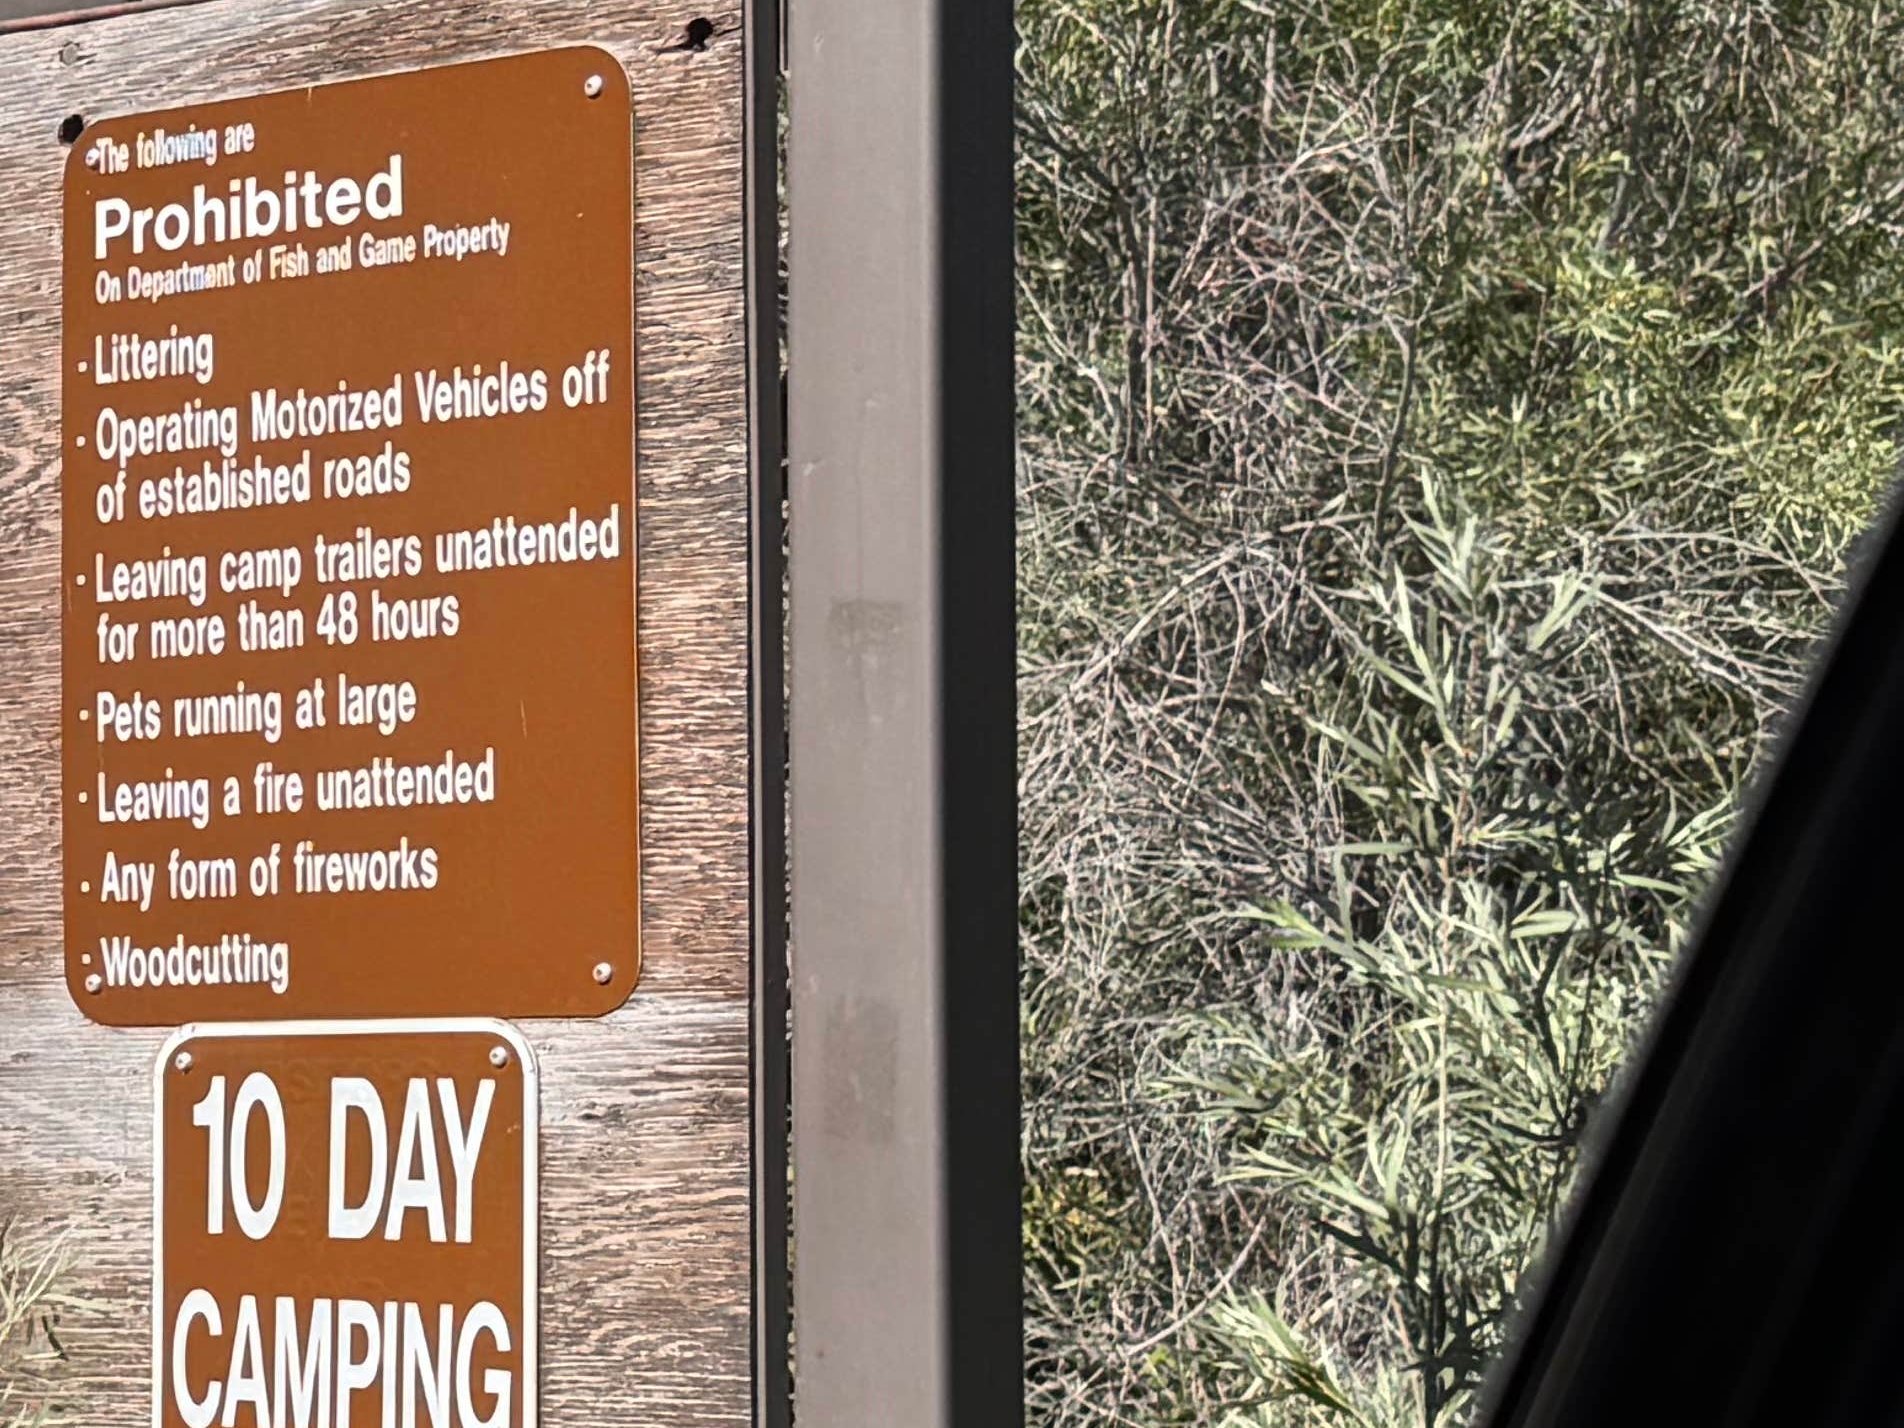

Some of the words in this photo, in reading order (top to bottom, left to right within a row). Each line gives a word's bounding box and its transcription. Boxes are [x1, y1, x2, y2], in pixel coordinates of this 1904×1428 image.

[95, 135, 128, 174] The
[136, 125, 218, 168] following
[224, 122, 255, 153] are
[95, 154, 404, 260] Prohibited
[95, 270, 121, 304] On
[128, 258, 235, 303] Department
[243, 253, 262, 283] of
[269, 245, 309, 279] Fish
[316, 236, 352, 273] and
[358, 230, 416, 266] Game
[423, 217, 510, 260] Property
[95, 324, 213, 385] Littering
[95, 399, 238, 468] Operating
[251, 374, 402, 443] Motorized
[414, 361, 547, 422] Vehicles
[562, 349, 610, 407] off
[96, 469, 126, 524] of
[139, 449, 311, 519] established
[323, 441, 411, 498] roads
[95, 547, 207, 606] Leaving
[219, 546, 301, 596] camp
[315, 528, 422, 585] trailers
[436, 504, 619, 572] unattended
[97, 613, 137, 663] for
[151, 616, 226, 659] more
[238, 599, 304, 651] than
[316, 592, 357, 646] 48
[371, 590, 460, 640] hours
[97, 690, 161, 742] Pets
[173, 682, 282, 743] running
[295, 678, 325, 729] at
[338, 674, 417, 735] large
[97, 768, 210, 829] Leaving
[223, 777, 240, 817] a
[254, 762, 303, 813] fire
[316, 747, 494, 809] unattended
[100, 851, 154, 911] Any
[168, 847, 237, 900] form
[249, 843, 280, 897] of
[293, 837, 438, 895] fireworks
[100, 933, 289, 994] Woodcutting
[192, 1071, 286, 1241] 10
[328, 1075, 496, 1244] DAY
